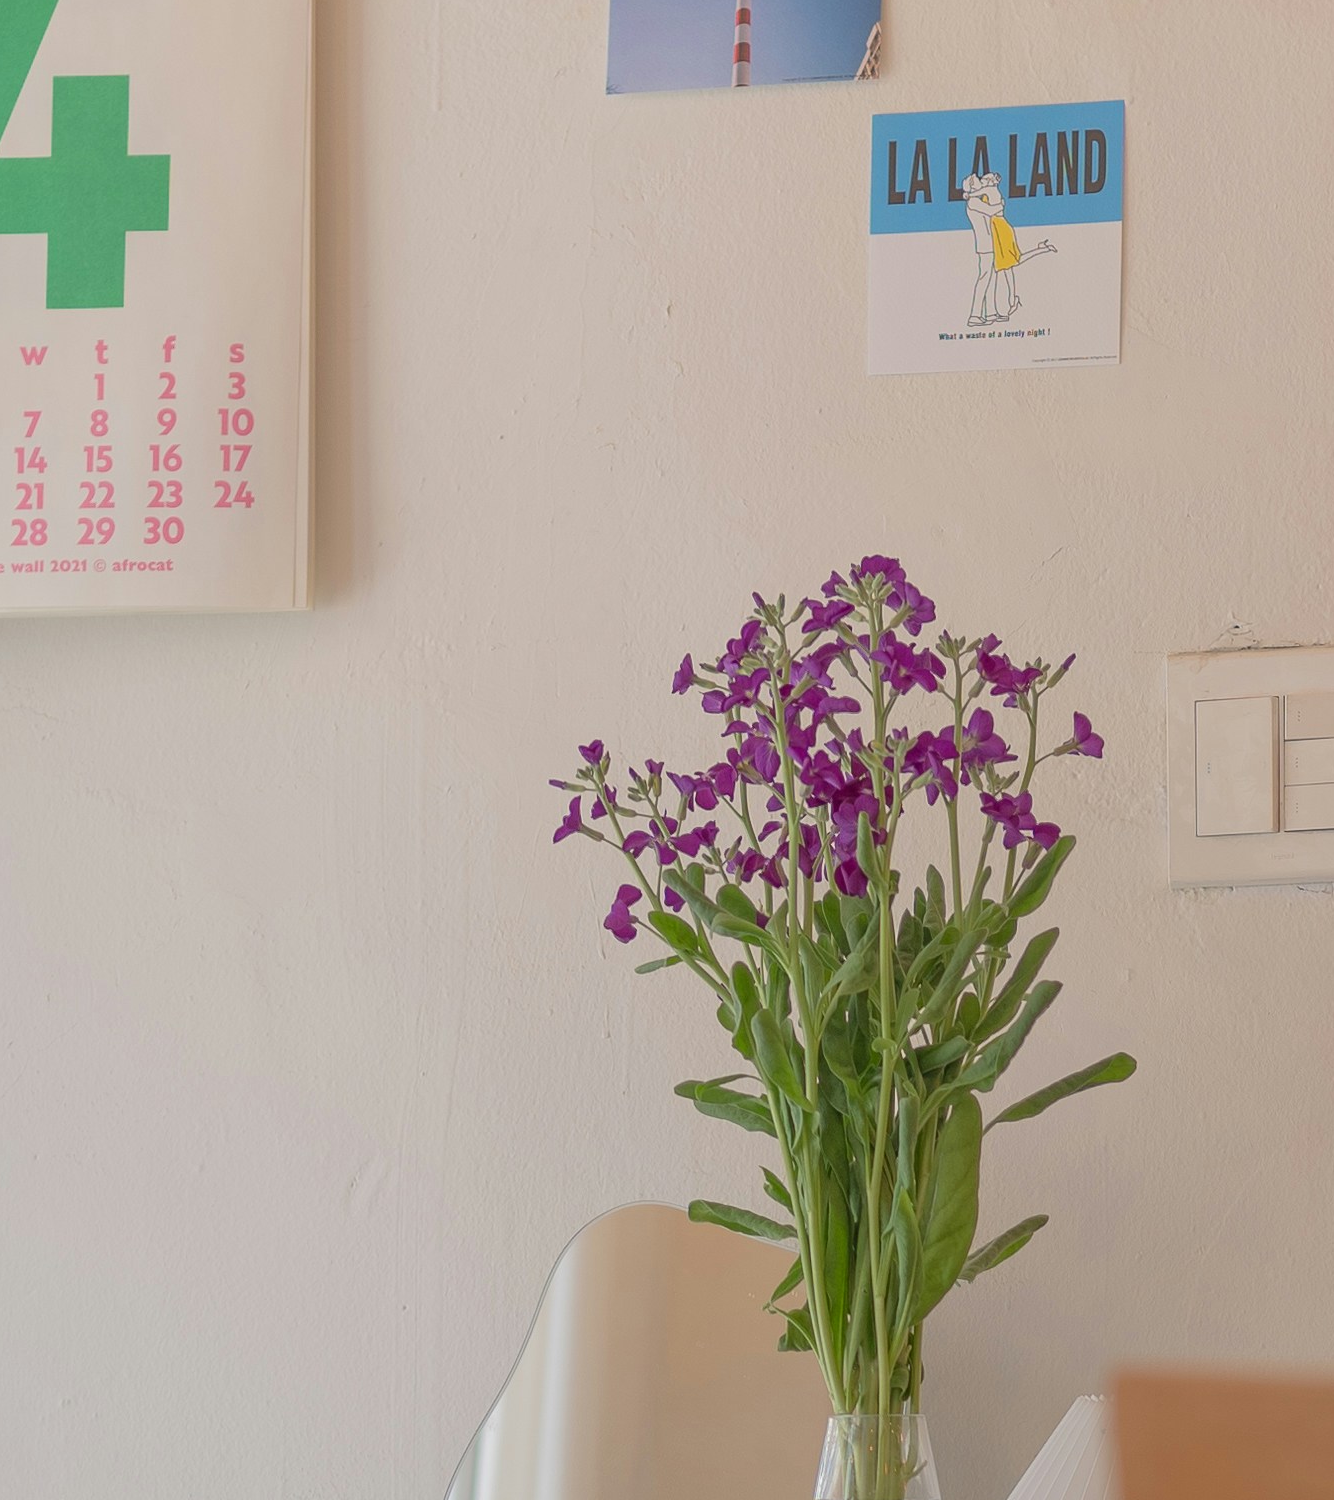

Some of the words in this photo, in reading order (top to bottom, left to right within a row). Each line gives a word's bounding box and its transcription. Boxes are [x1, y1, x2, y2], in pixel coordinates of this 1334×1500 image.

[887, 139, 933, 205] LA
[947, 135, 991, 202] LA
[1008, 129, 1108, 199] LAND
[19, 345, 49, 367] w
[94, 339, 108, 366] t
[162, 334, 177, 364] f
[228, 342, 246, 365] s
[938, 332, 957, 341] What
[988, 331, 996, 339] of
[1004, 329, 1025, 338] lovely
[93, 372, 106, 402] 1
[158, 370, 178, 401] 2
[226, 371, 248, 401] 3
[22, 409, 43, 438] 7
[89, 409, 109, 438] 8
[156, 407, 178, 437] 9
[218, 406, 256, 438] 10
[14, 445, 48, 475] 14
[83, 443, 114, 474] 15
[148, 443, 184, 473] 16
[219, 443, 252, 473] 17
[15, 481, 45, 511] 21
[79, 479, 116, 510] 22
[146, 479, 184, 510] 23
[213, 479, 256, 510] 24
[10, 517, 49, 547] 28
[77, 516, 117, 546] 29
[142, 515, 186, 546] 30
[11, 560, 45, 574] wall
[50, 559, 88, 573] 2021
[112, 558, 174, 573] afrocat
